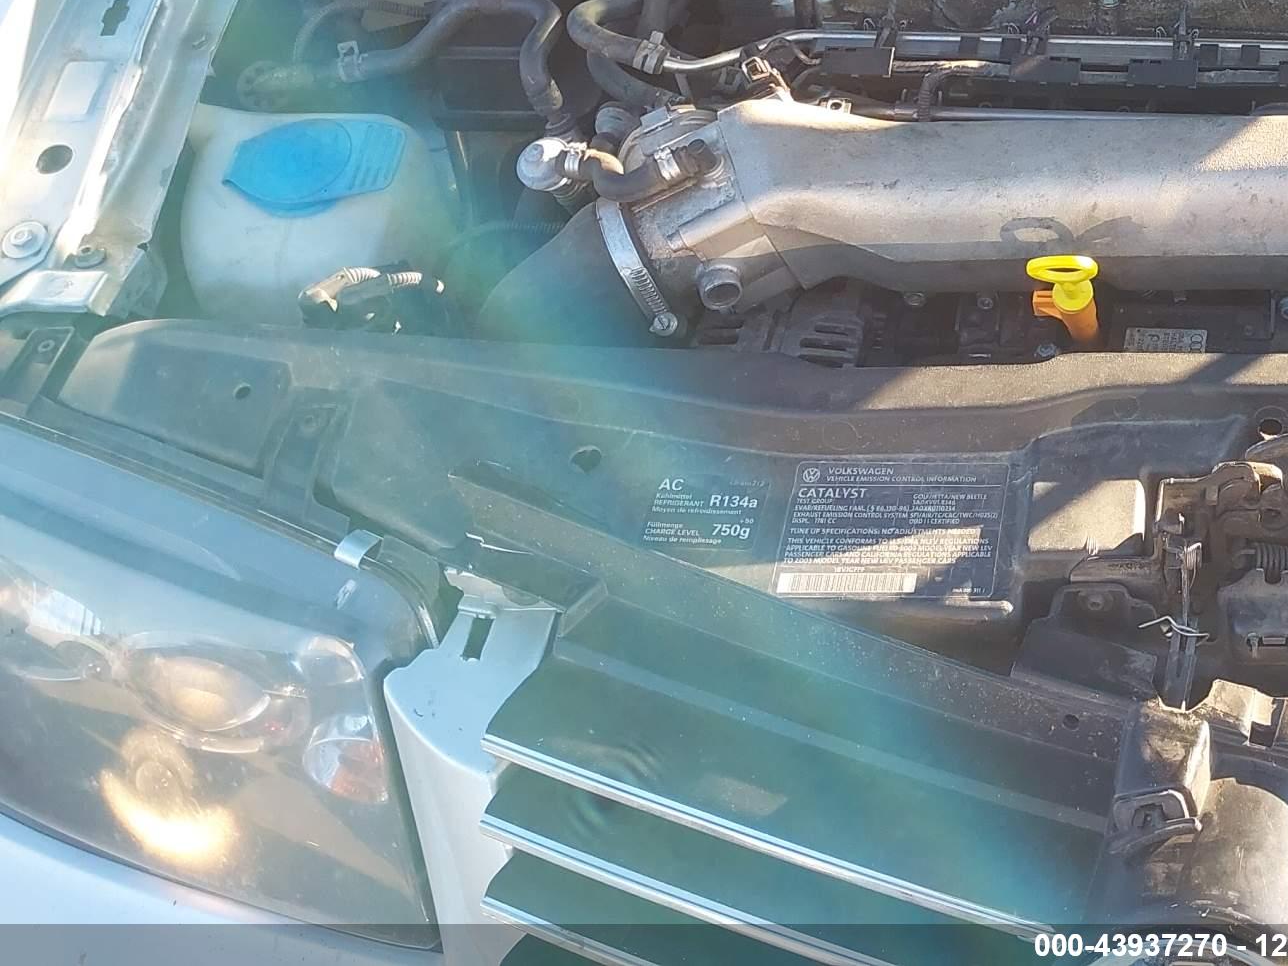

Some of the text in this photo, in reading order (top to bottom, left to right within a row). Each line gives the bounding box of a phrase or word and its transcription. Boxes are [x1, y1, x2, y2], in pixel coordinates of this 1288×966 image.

[828, 467, 894, 475] VOLKSWAGEN
[658, 478, 684, 491] AC
[798, 488, 867, 499] CATALYST
[654, 499, 704, 507] REFRIGERANT
[709, 494, 758, 508] R134a
[652, 506, 675, 514] Moyen
[677, 529, 700, 537] LEVEL
[711, 524, 751, 539] 750g
